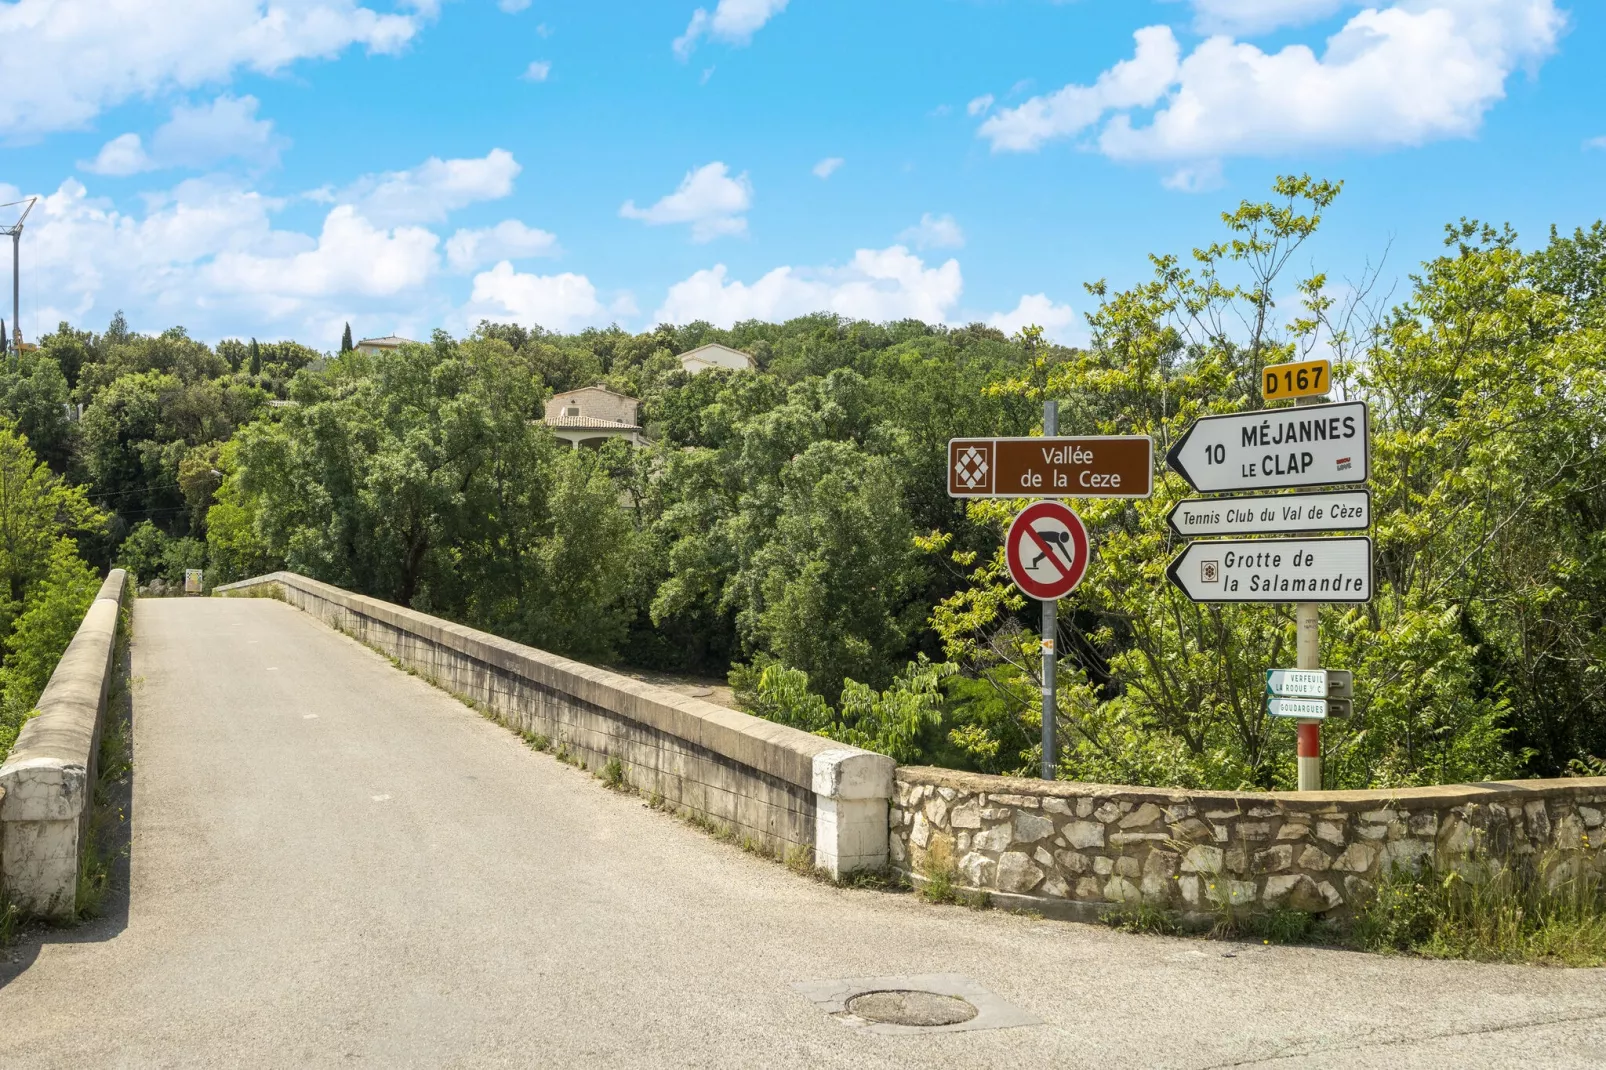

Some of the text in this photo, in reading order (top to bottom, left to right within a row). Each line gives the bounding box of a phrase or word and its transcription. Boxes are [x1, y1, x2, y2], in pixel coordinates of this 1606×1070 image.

[1267, 367, 1323, 394] D 167
[1241, 417, 1356, 447] MÉJANNES
[1042, 446, 1093, 465] Vallée
[1205, 444, 1226, 465] 10
[1242, 452, 1313, 478] LE CLAP
[1021, 469, 1121, 488] de la Ceze
[1184, 504, 1363, 525] Tennis Club du Val de Cèze
[1224, 550, 1314, 568] Grotte de
[1224, 574, 1363, 592] la Salamandre
[1286, 684, 1307, 692] ROQUE
[1291, 675, 1323, 683] VERFEUIL
[1281, 704, 1323, 713] GOUDARGUES
